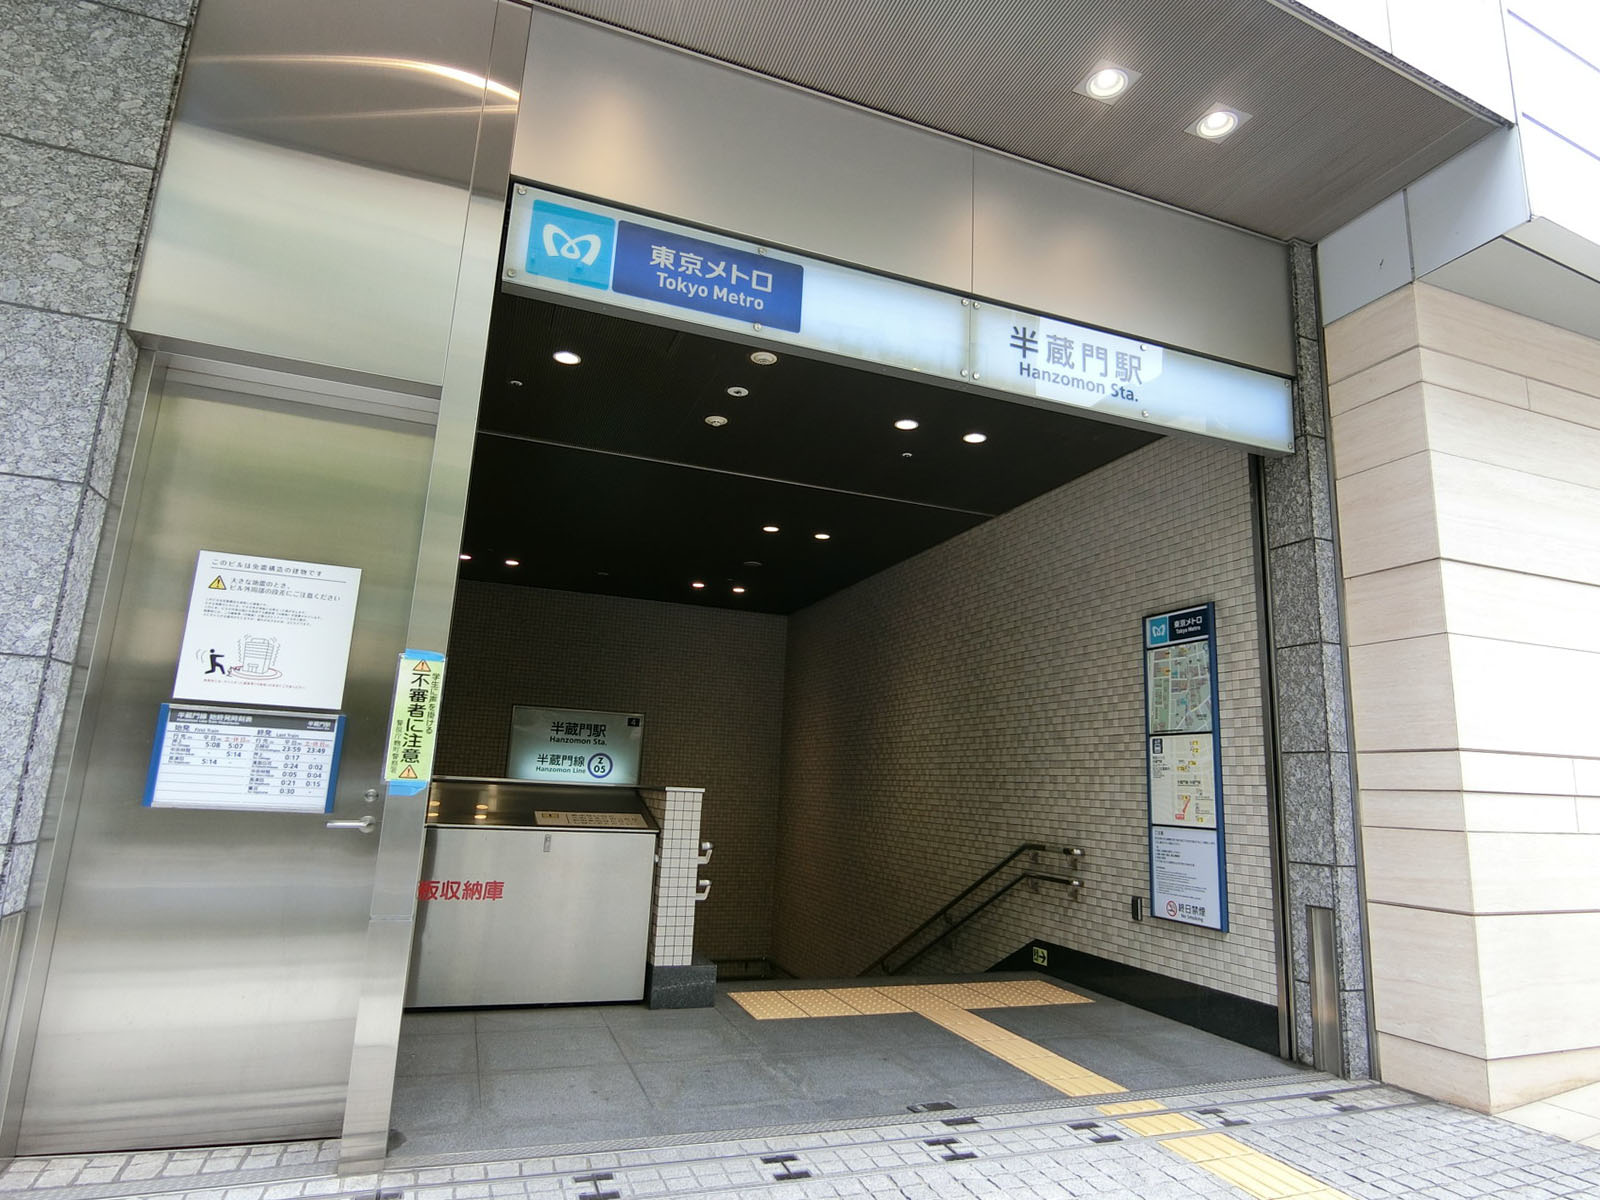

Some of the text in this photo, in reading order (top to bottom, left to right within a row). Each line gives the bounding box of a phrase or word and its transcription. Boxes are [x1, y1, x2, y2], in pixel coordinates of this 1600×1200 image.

[649, 244, 773, 293] 東京メトロ
[657, 272, 765, 311] Tokyo Metro
[1009, 326, 1143, 386] 半蔵門駅
[1019, 362, 1139, 402] Hanzomon Sta.
[400, 672, 430, 764] 不審者に注意
[550, 721, 607, 738] 半蔵門駅
[550, 735, 607, 746] Hanzomon Sta.
[537, 753, 585, 767] 半蔵門線
[536, 766, 571, 774] Hanzomon
[594, 764, 606, 774] 05
[1178, 903, 1206, 917] 終日禁煙
